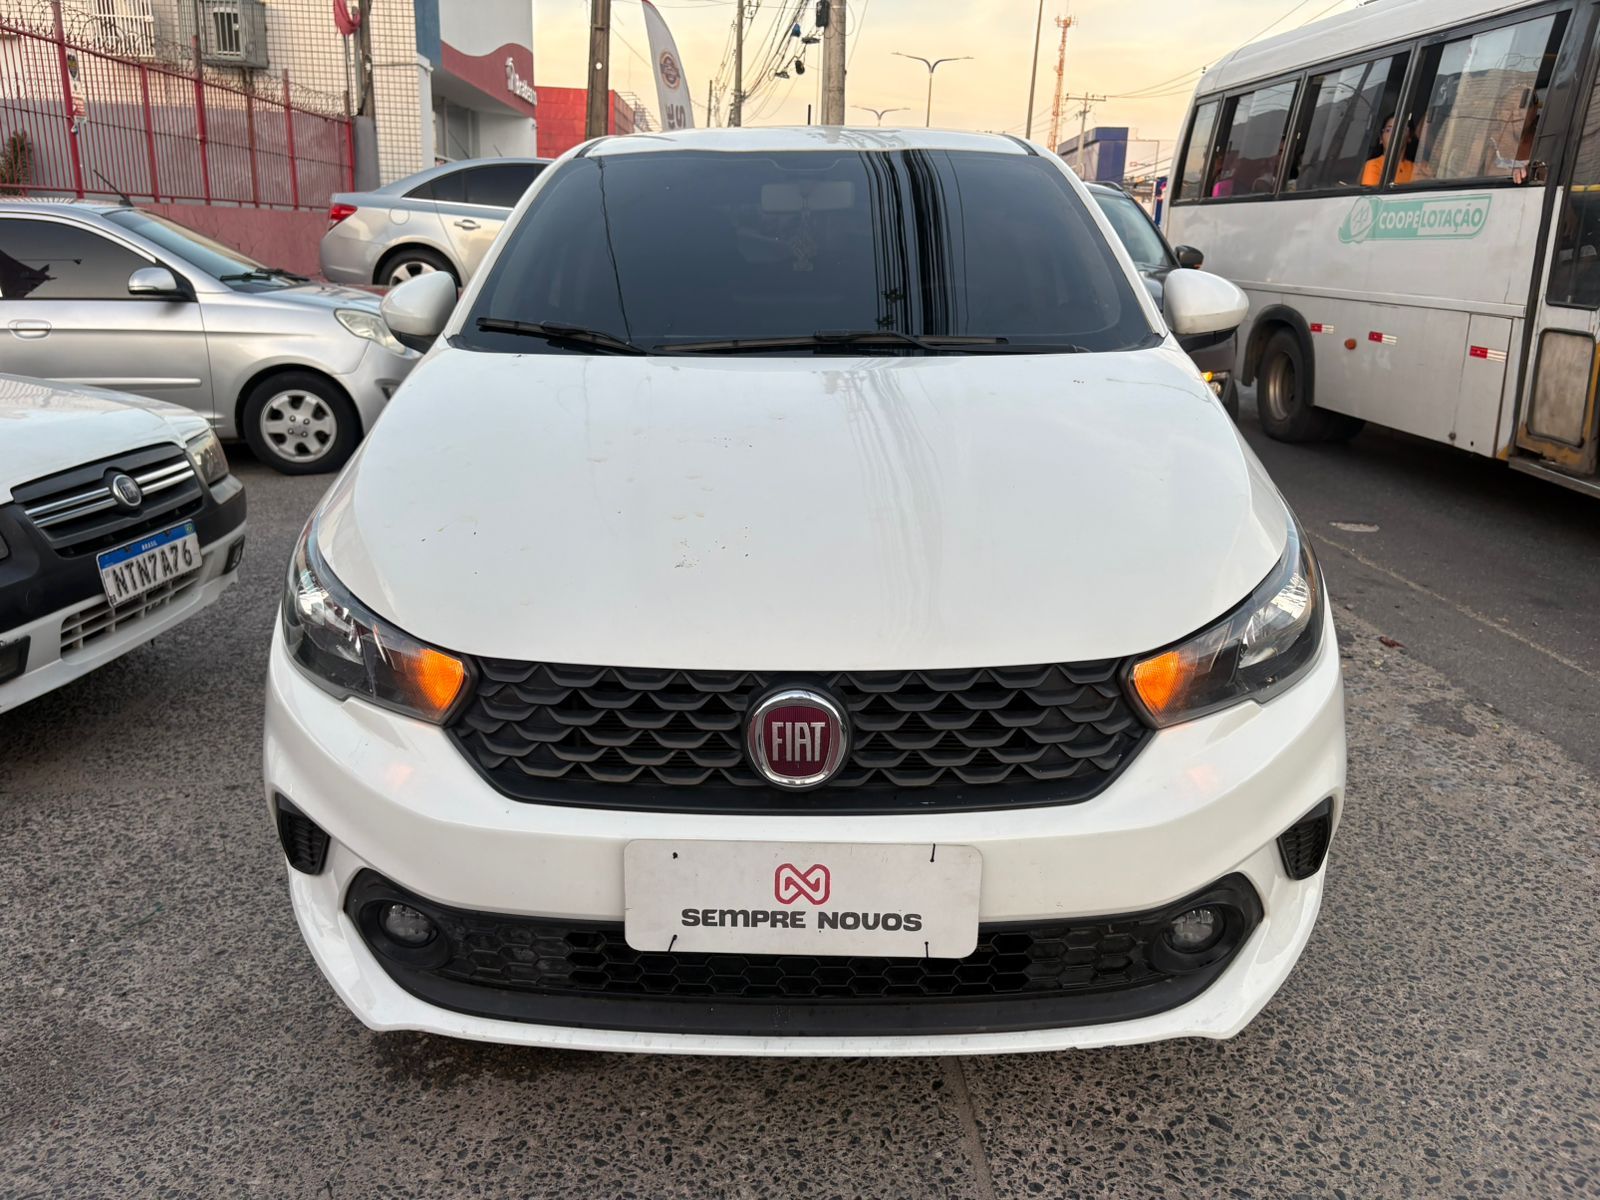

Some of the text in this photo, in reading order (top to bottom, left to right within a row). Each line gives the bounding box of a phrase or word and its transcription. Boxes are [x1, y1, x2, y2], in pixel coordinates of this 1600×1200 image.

[1379, 203, 1483, 232] COOPELOTAÇÃO
[141, 541, 158, 551] BRASIL
[112, 540, 193, 598] NTN7A76
[771, 721, 826, 762] FIAT
[681, 908, 923, 932] SEMPRE NOVOS
